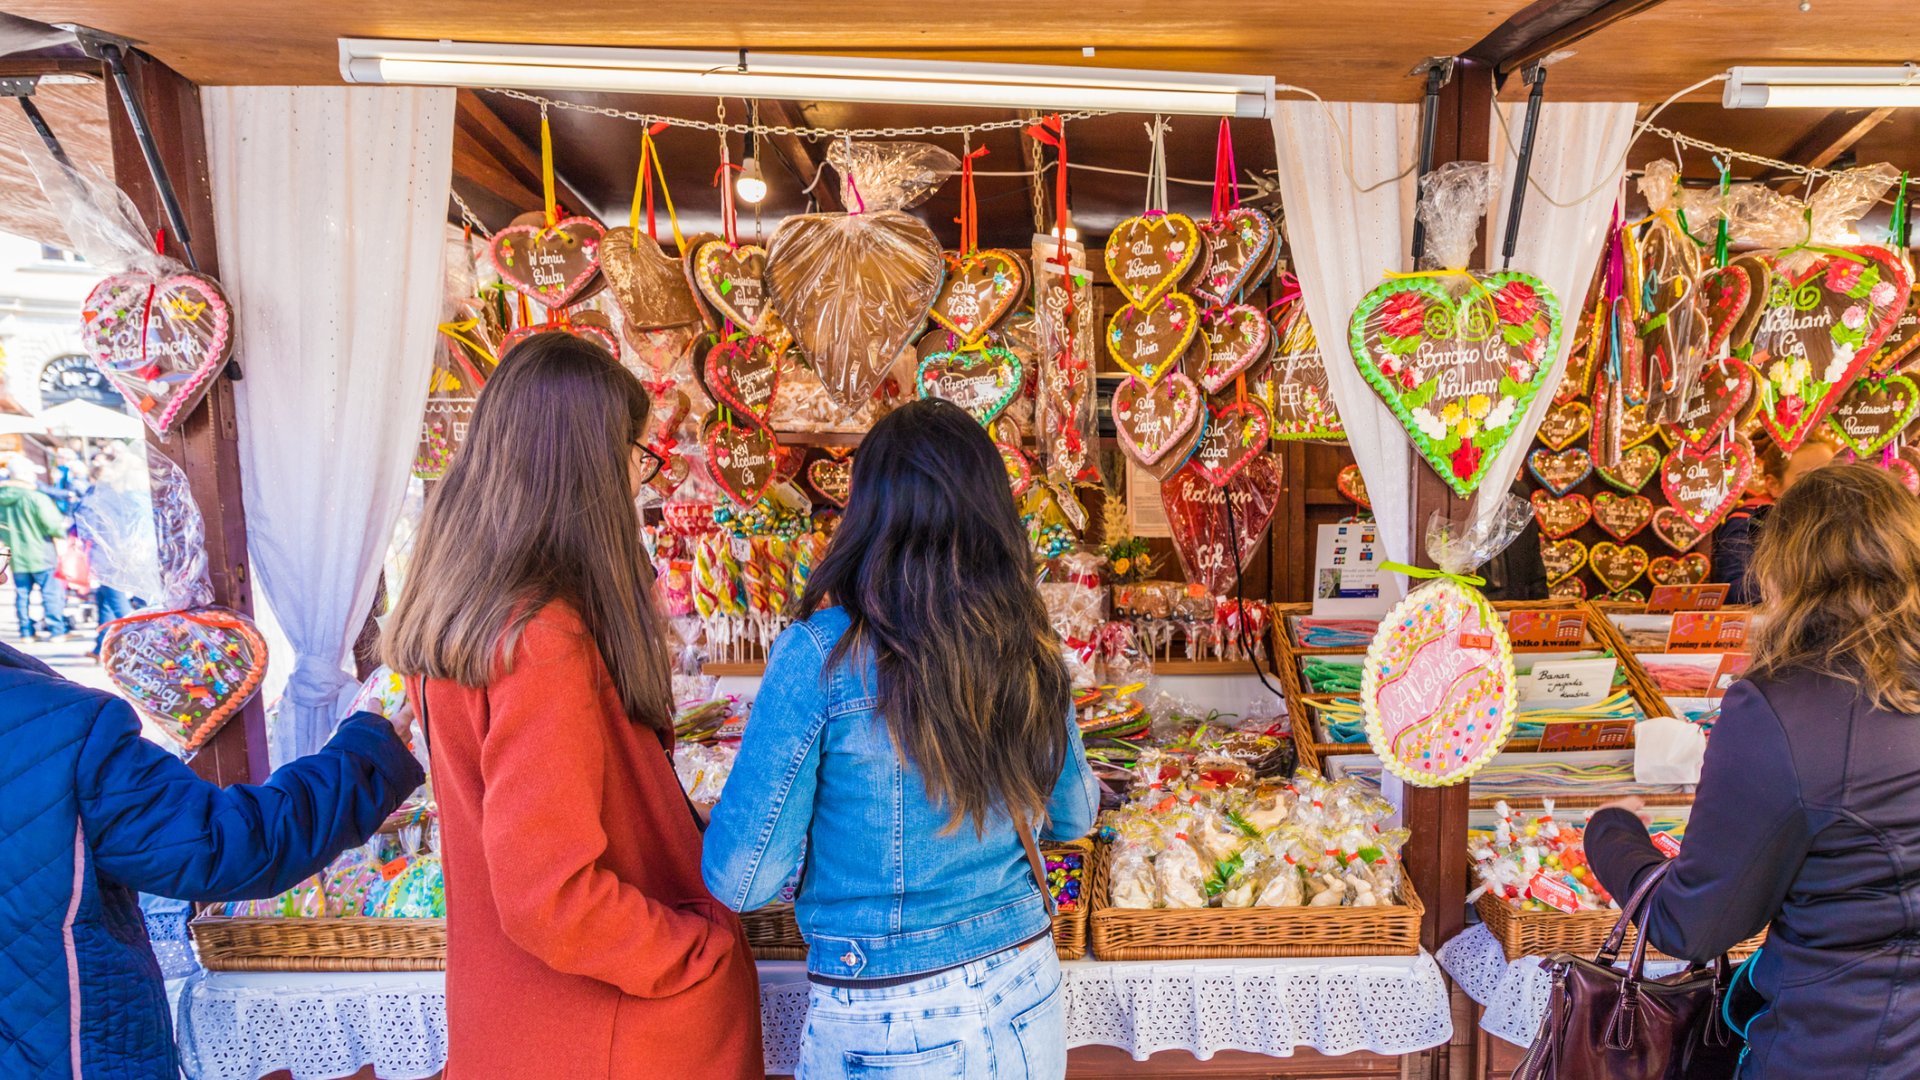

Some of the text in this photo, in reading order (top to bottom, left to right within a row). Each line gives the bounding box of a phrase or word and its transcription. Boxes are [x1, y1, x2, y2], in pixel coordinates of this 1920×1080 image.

[1131, 234, 1154, 256] Dla
[527, 246, 566, 266] W dniu
[1134, 315, 1156, 337] Dla
[1416, 341, 1480, 369] Bardzo
[1843, 416, 1880, 436] Razem
[1686, 460, 1709, 480] Dla
